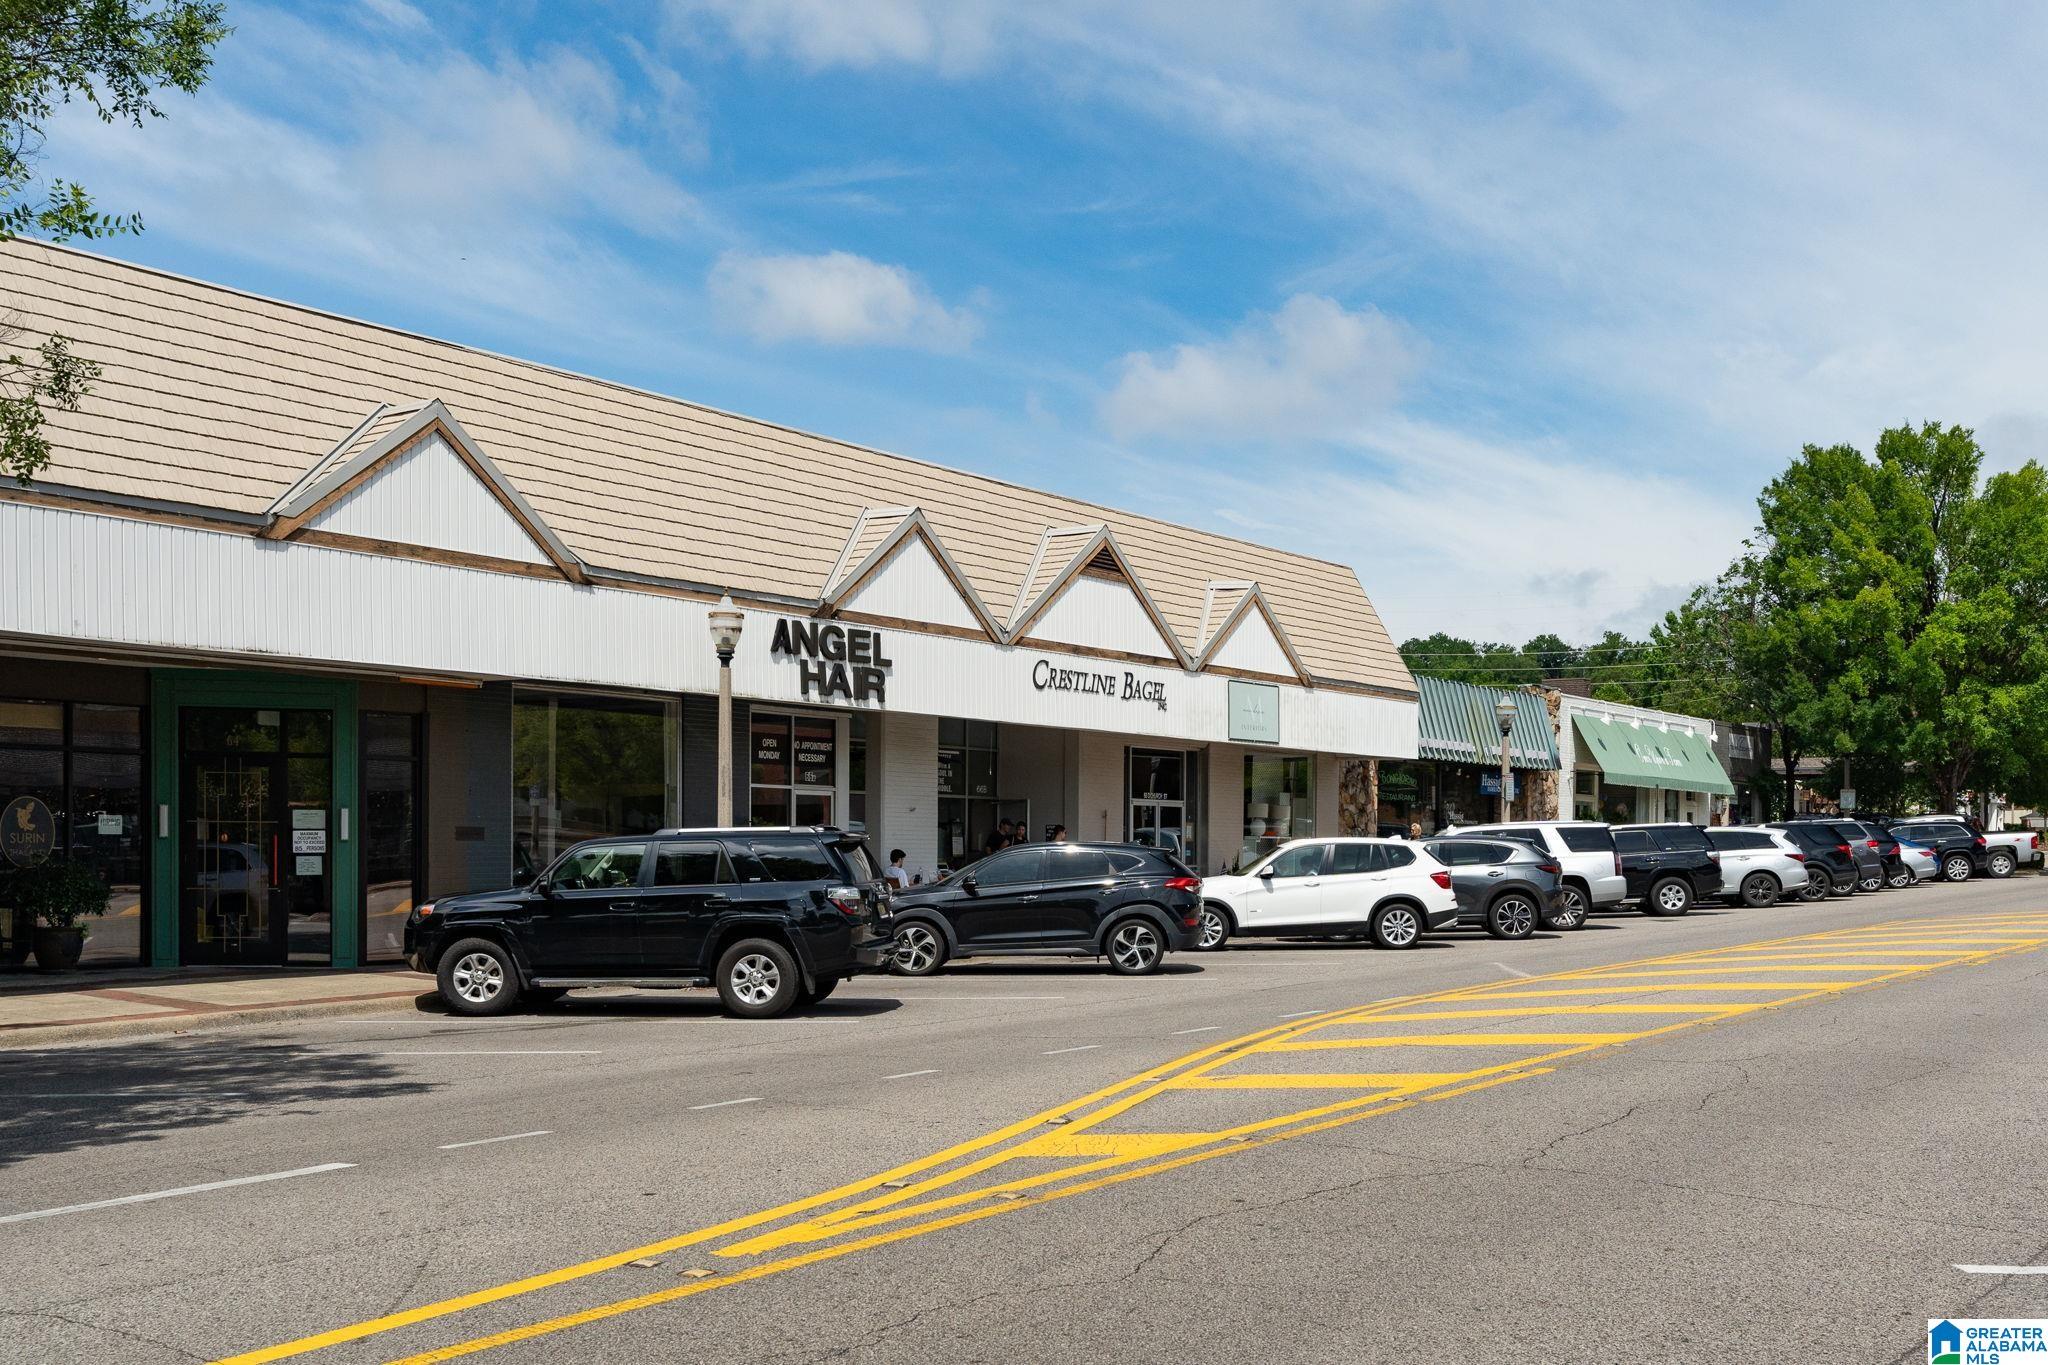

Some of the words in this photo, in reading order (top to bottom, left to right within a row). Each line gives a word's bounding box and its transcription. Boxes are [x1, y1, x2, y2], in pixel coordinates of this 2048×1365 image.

[770, 618, 892, 667] ANGEL
[800, 659, 885, 702] HAIR
[762, 738, 777, 747] OPEN
[801, 742, 832, 751] APPOINTMENT
[758, 750, 780, 760] MONDAY
[798, 753, 826, 763] NECESSARY
[9, 832, 46, 844] SURIN
